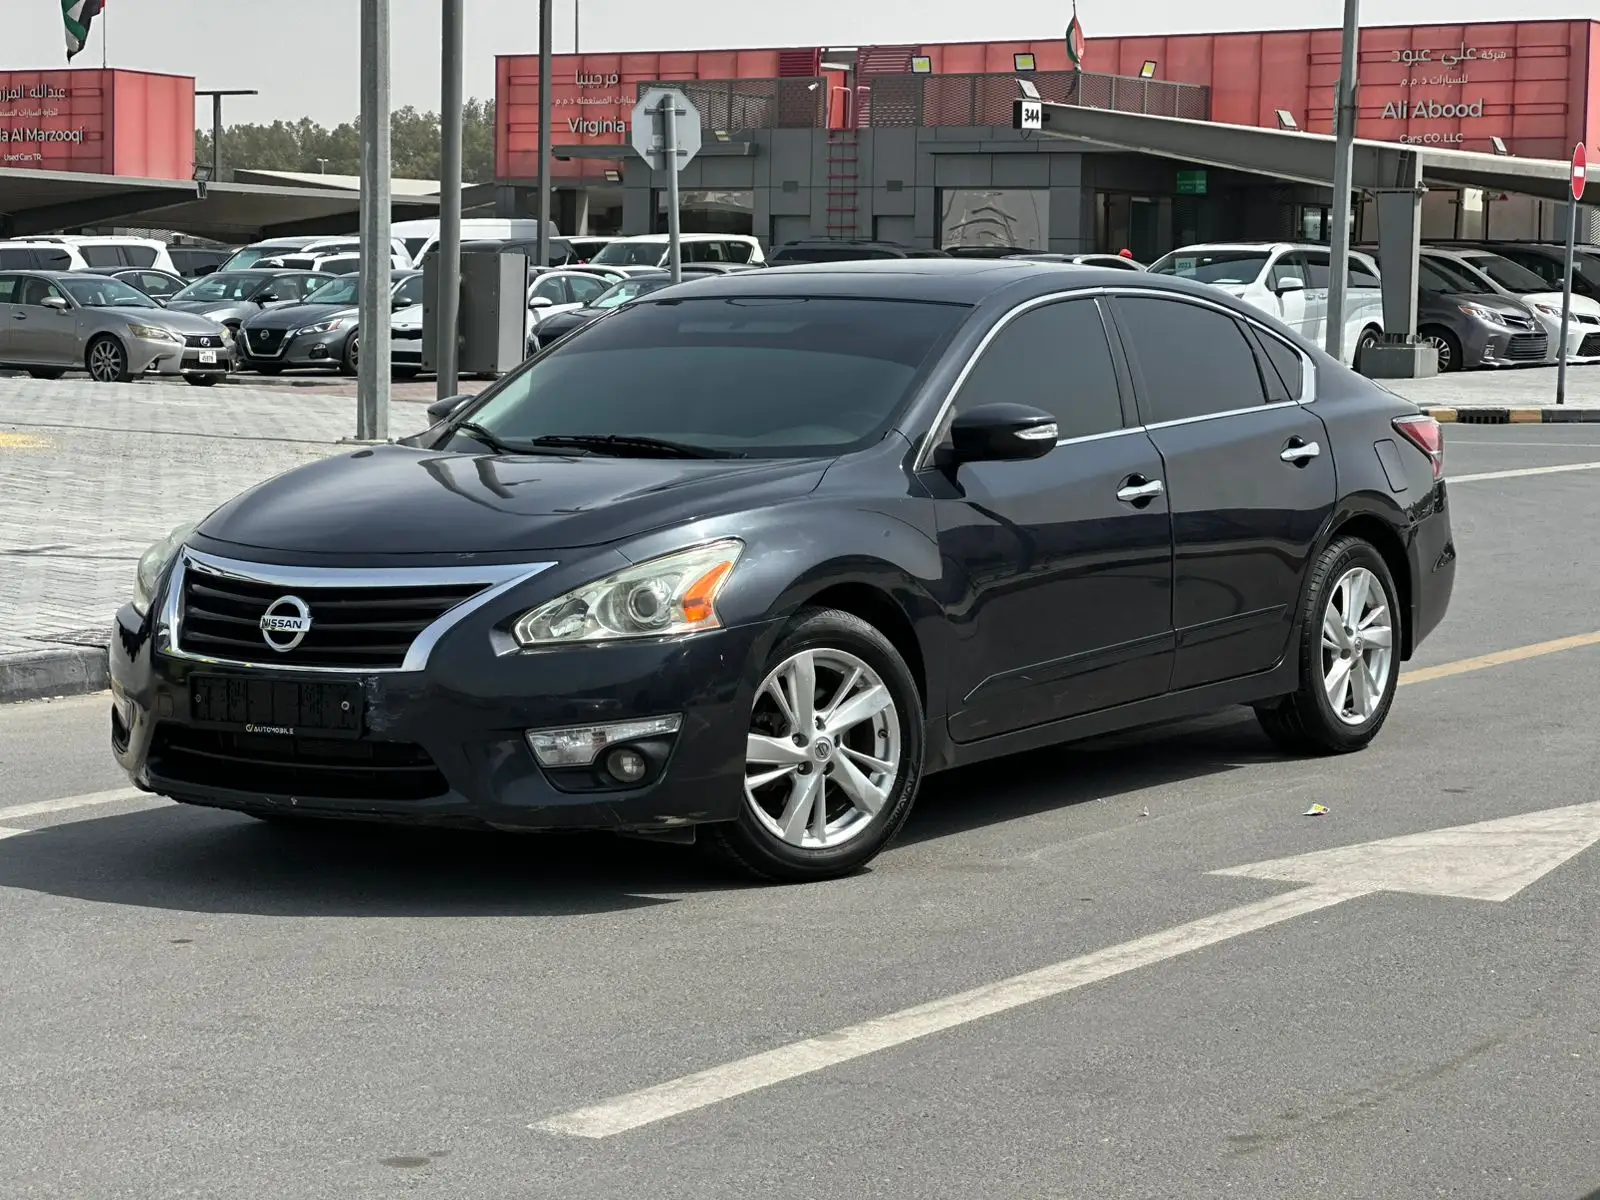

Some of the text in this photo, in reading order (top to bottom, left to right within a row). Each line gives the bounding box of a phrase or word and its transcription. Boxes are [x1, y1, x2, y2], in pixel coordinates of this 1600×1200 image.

[1391, 42, 1506, 69] شركة علي عبود
[576, 69, 618, 88] فرجينيا
[1024, 108, 1040, 123] 344
[1381, 98, 1483, 119] Ali Abood
[567, 116, 625, 137] Virginia
[11, 127, 23, 142] Al
[26, 126, 83, 144] Marzooqi
[1399, 134, 1422, 144] Cars
[4, 153, 19, 161] Used
[20, 153, 32, 161] Cars
[261, 618, 302, 629] NISSAN
[253, 726, 294, 735] AUTOMOBILE
